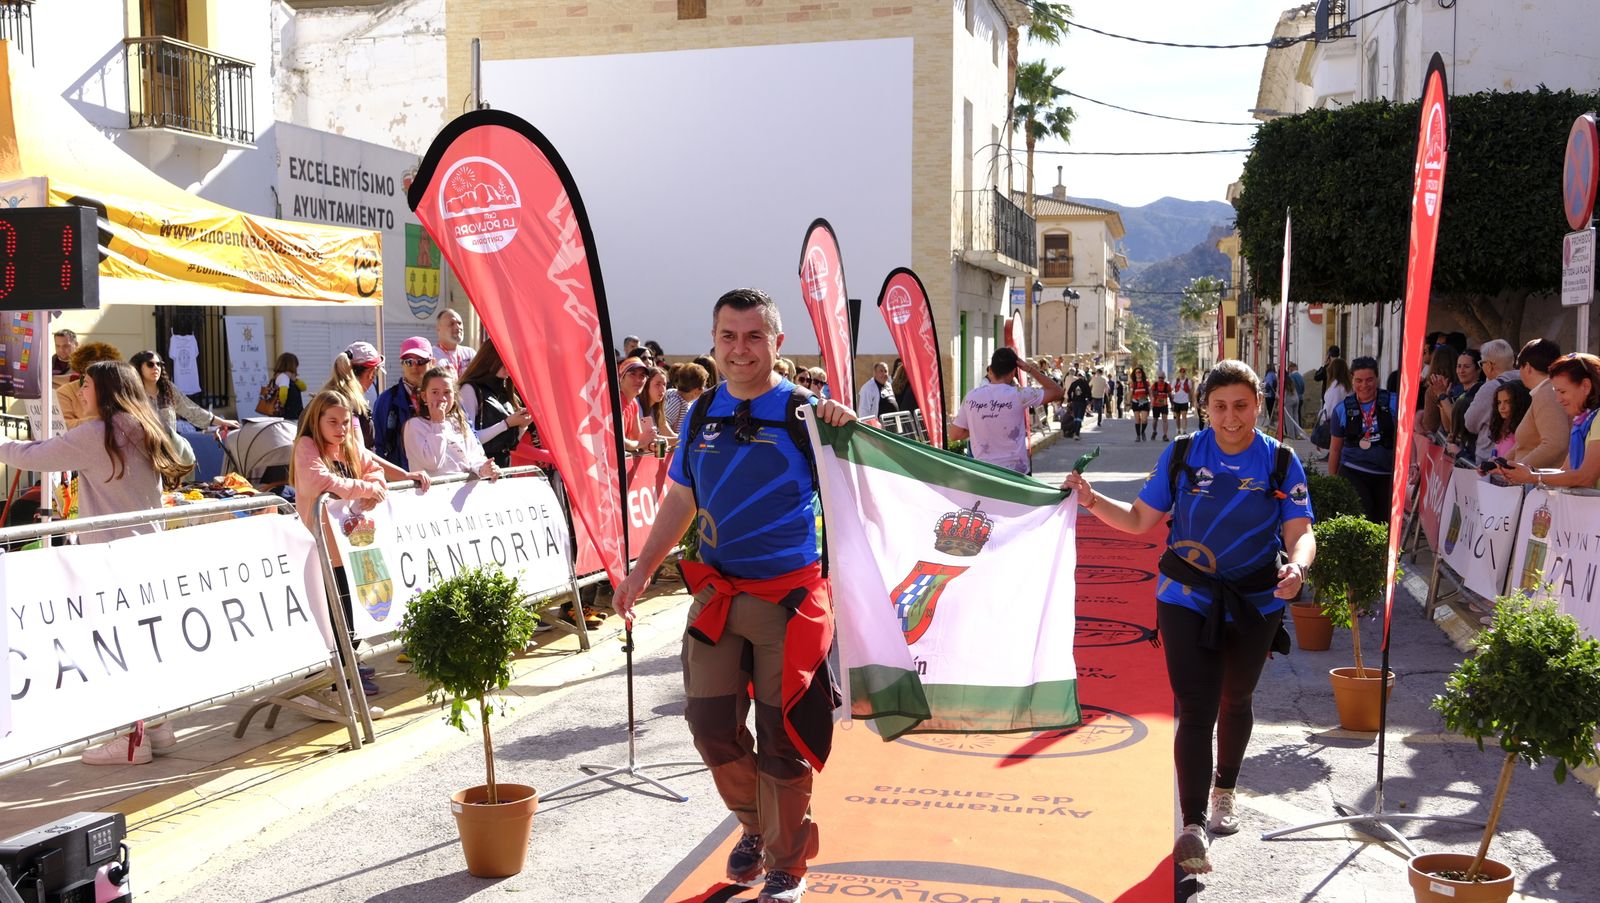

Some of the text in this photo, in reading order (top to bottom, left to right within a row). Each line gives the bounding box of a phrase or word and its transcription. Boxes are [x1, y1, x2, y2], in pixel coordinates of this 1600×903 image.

[289, 156, 395, 197] EXCELENTÍSIMO
[293, 198, 394, 229] AYUNTAMIENTO
[396, 504, 551, 544] AYUNTAMIENTO DE
[400, 526, 559, 588] CANTORIA
[10, 553, 291, 630] YUNTAMIENTO DE
[844, 794, 1093, 819] Ayuntamiento
[873, 784, 1074, 805] de Cantoria
[808, 873, 920, 888] Cantoria
